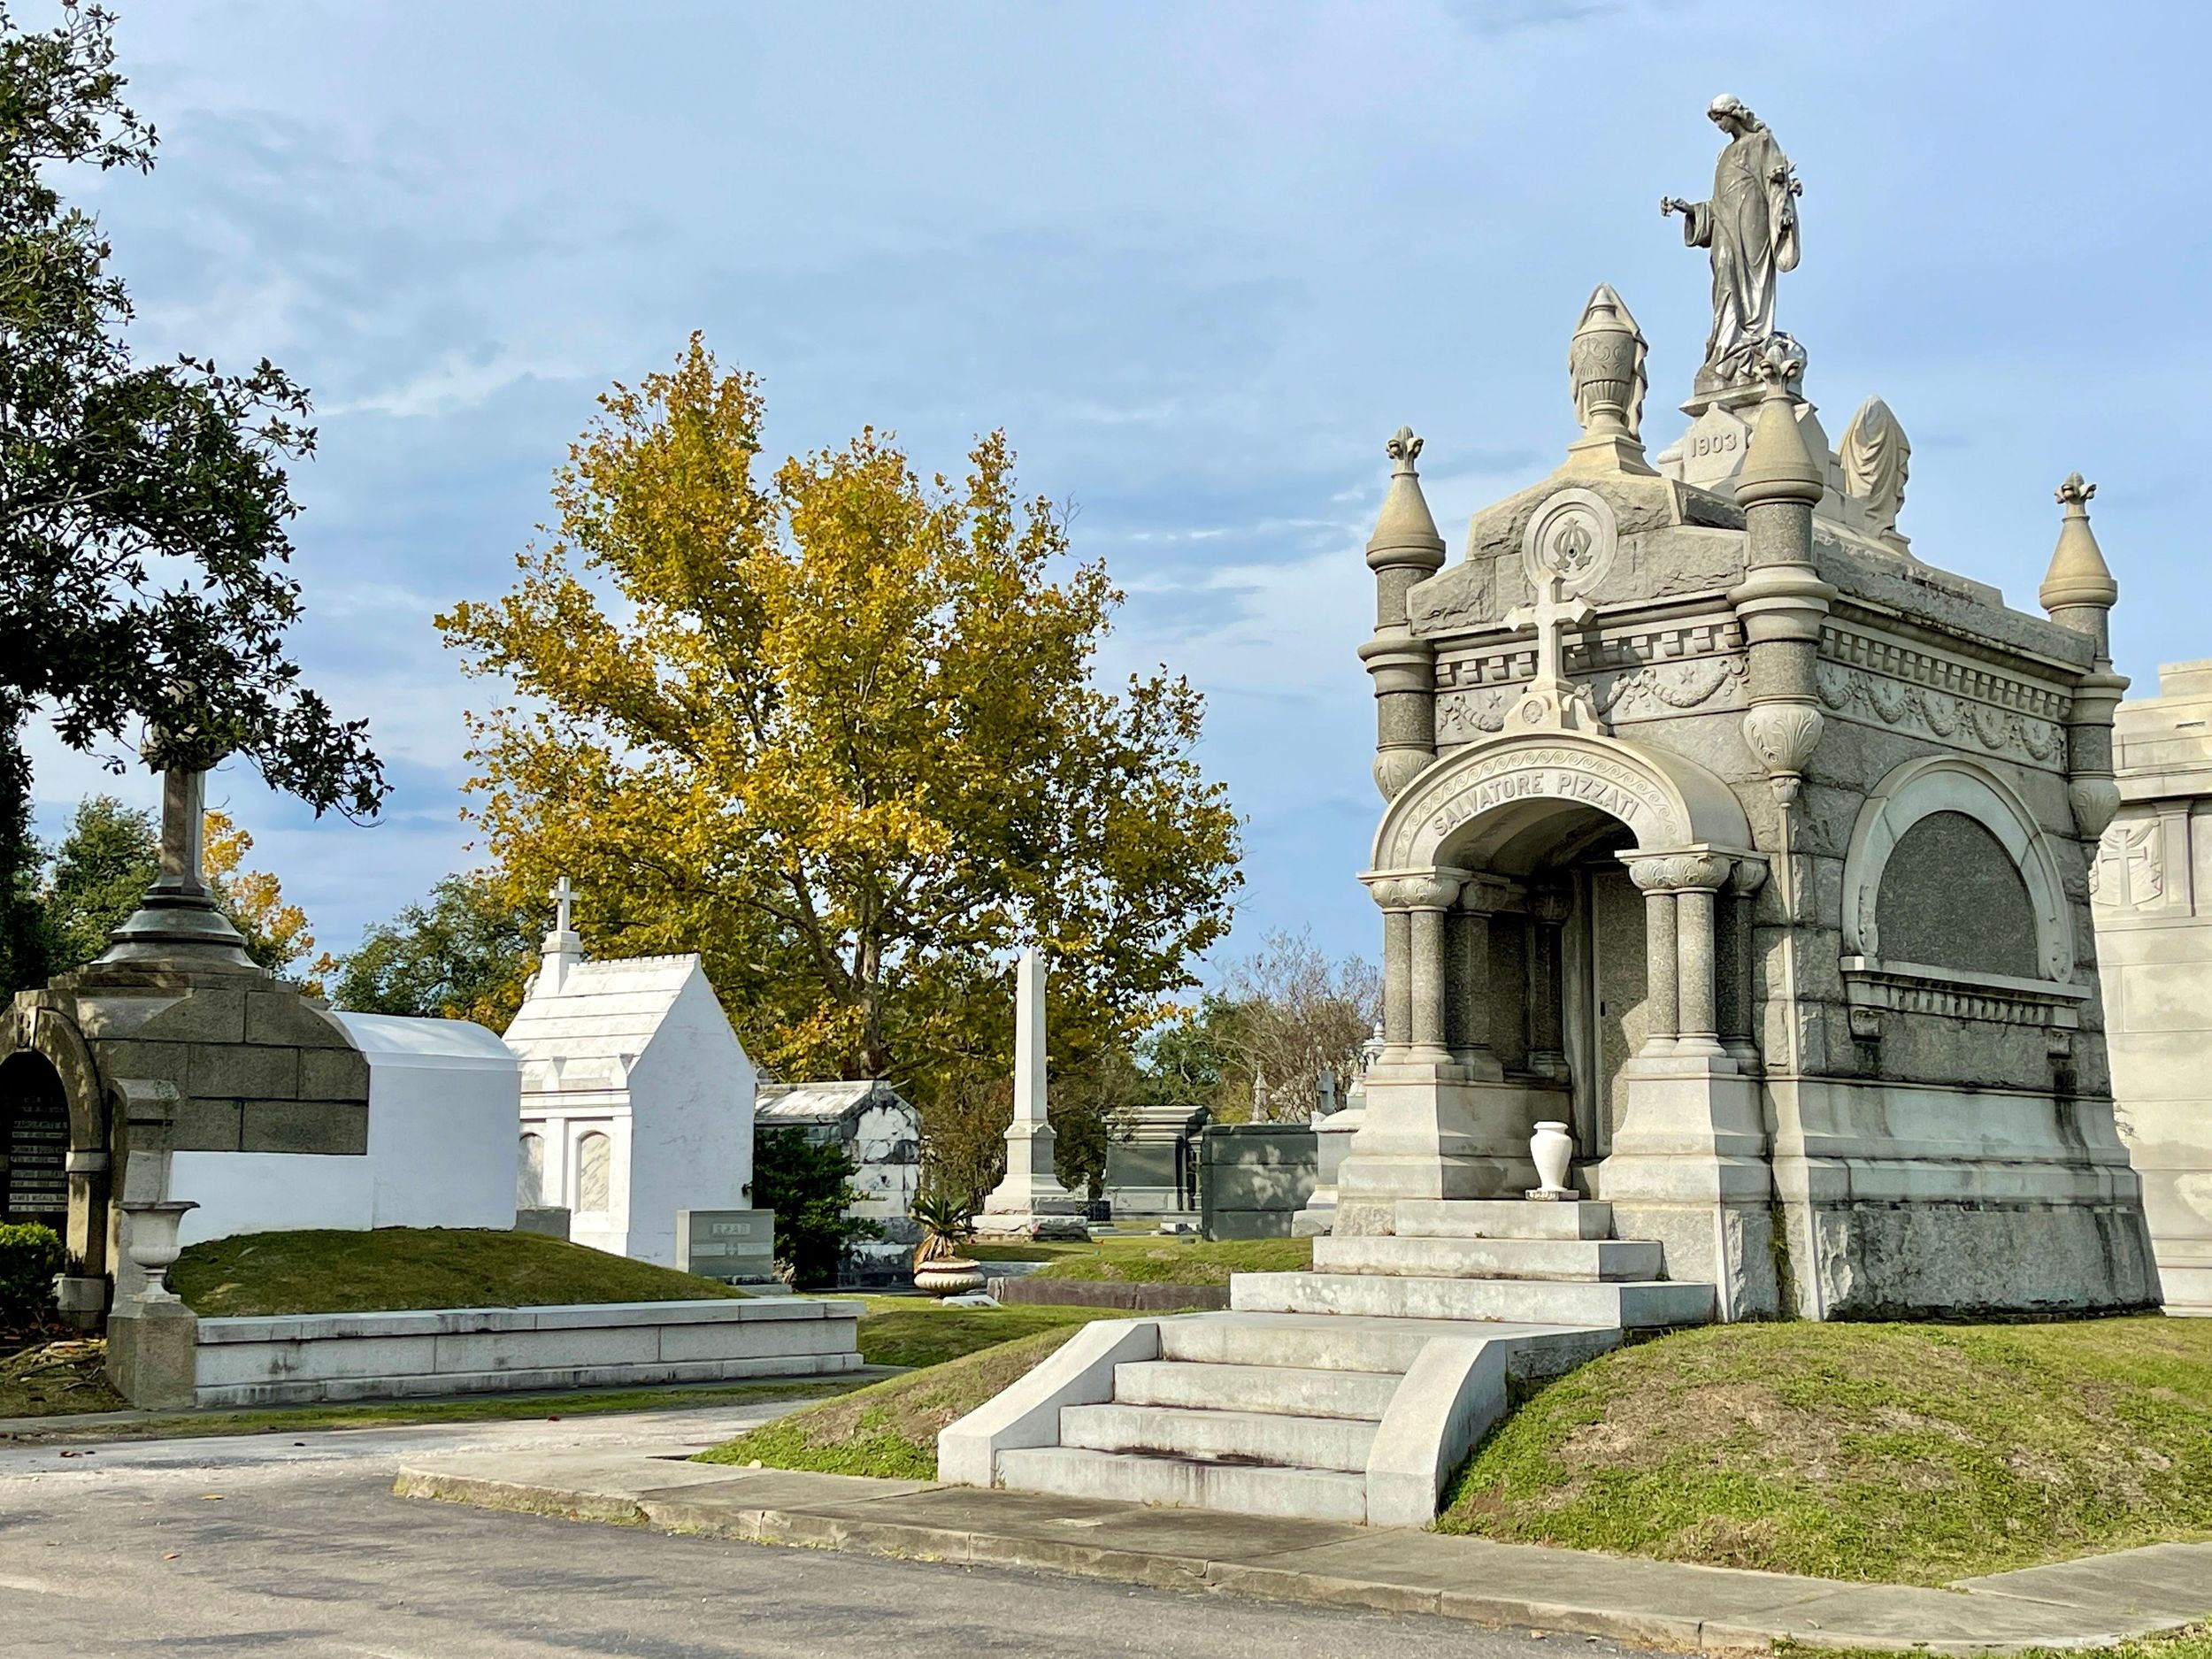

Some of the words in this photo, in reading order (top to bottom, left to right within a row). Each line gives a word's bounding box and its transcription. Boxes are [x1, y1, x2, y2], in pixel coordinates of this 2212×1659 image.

[1692, 433, 1737, 457] 1903
[1433, 772, 1544, 836] SALVATORE
[1557, 773, 1640, 821] PIZZATI
